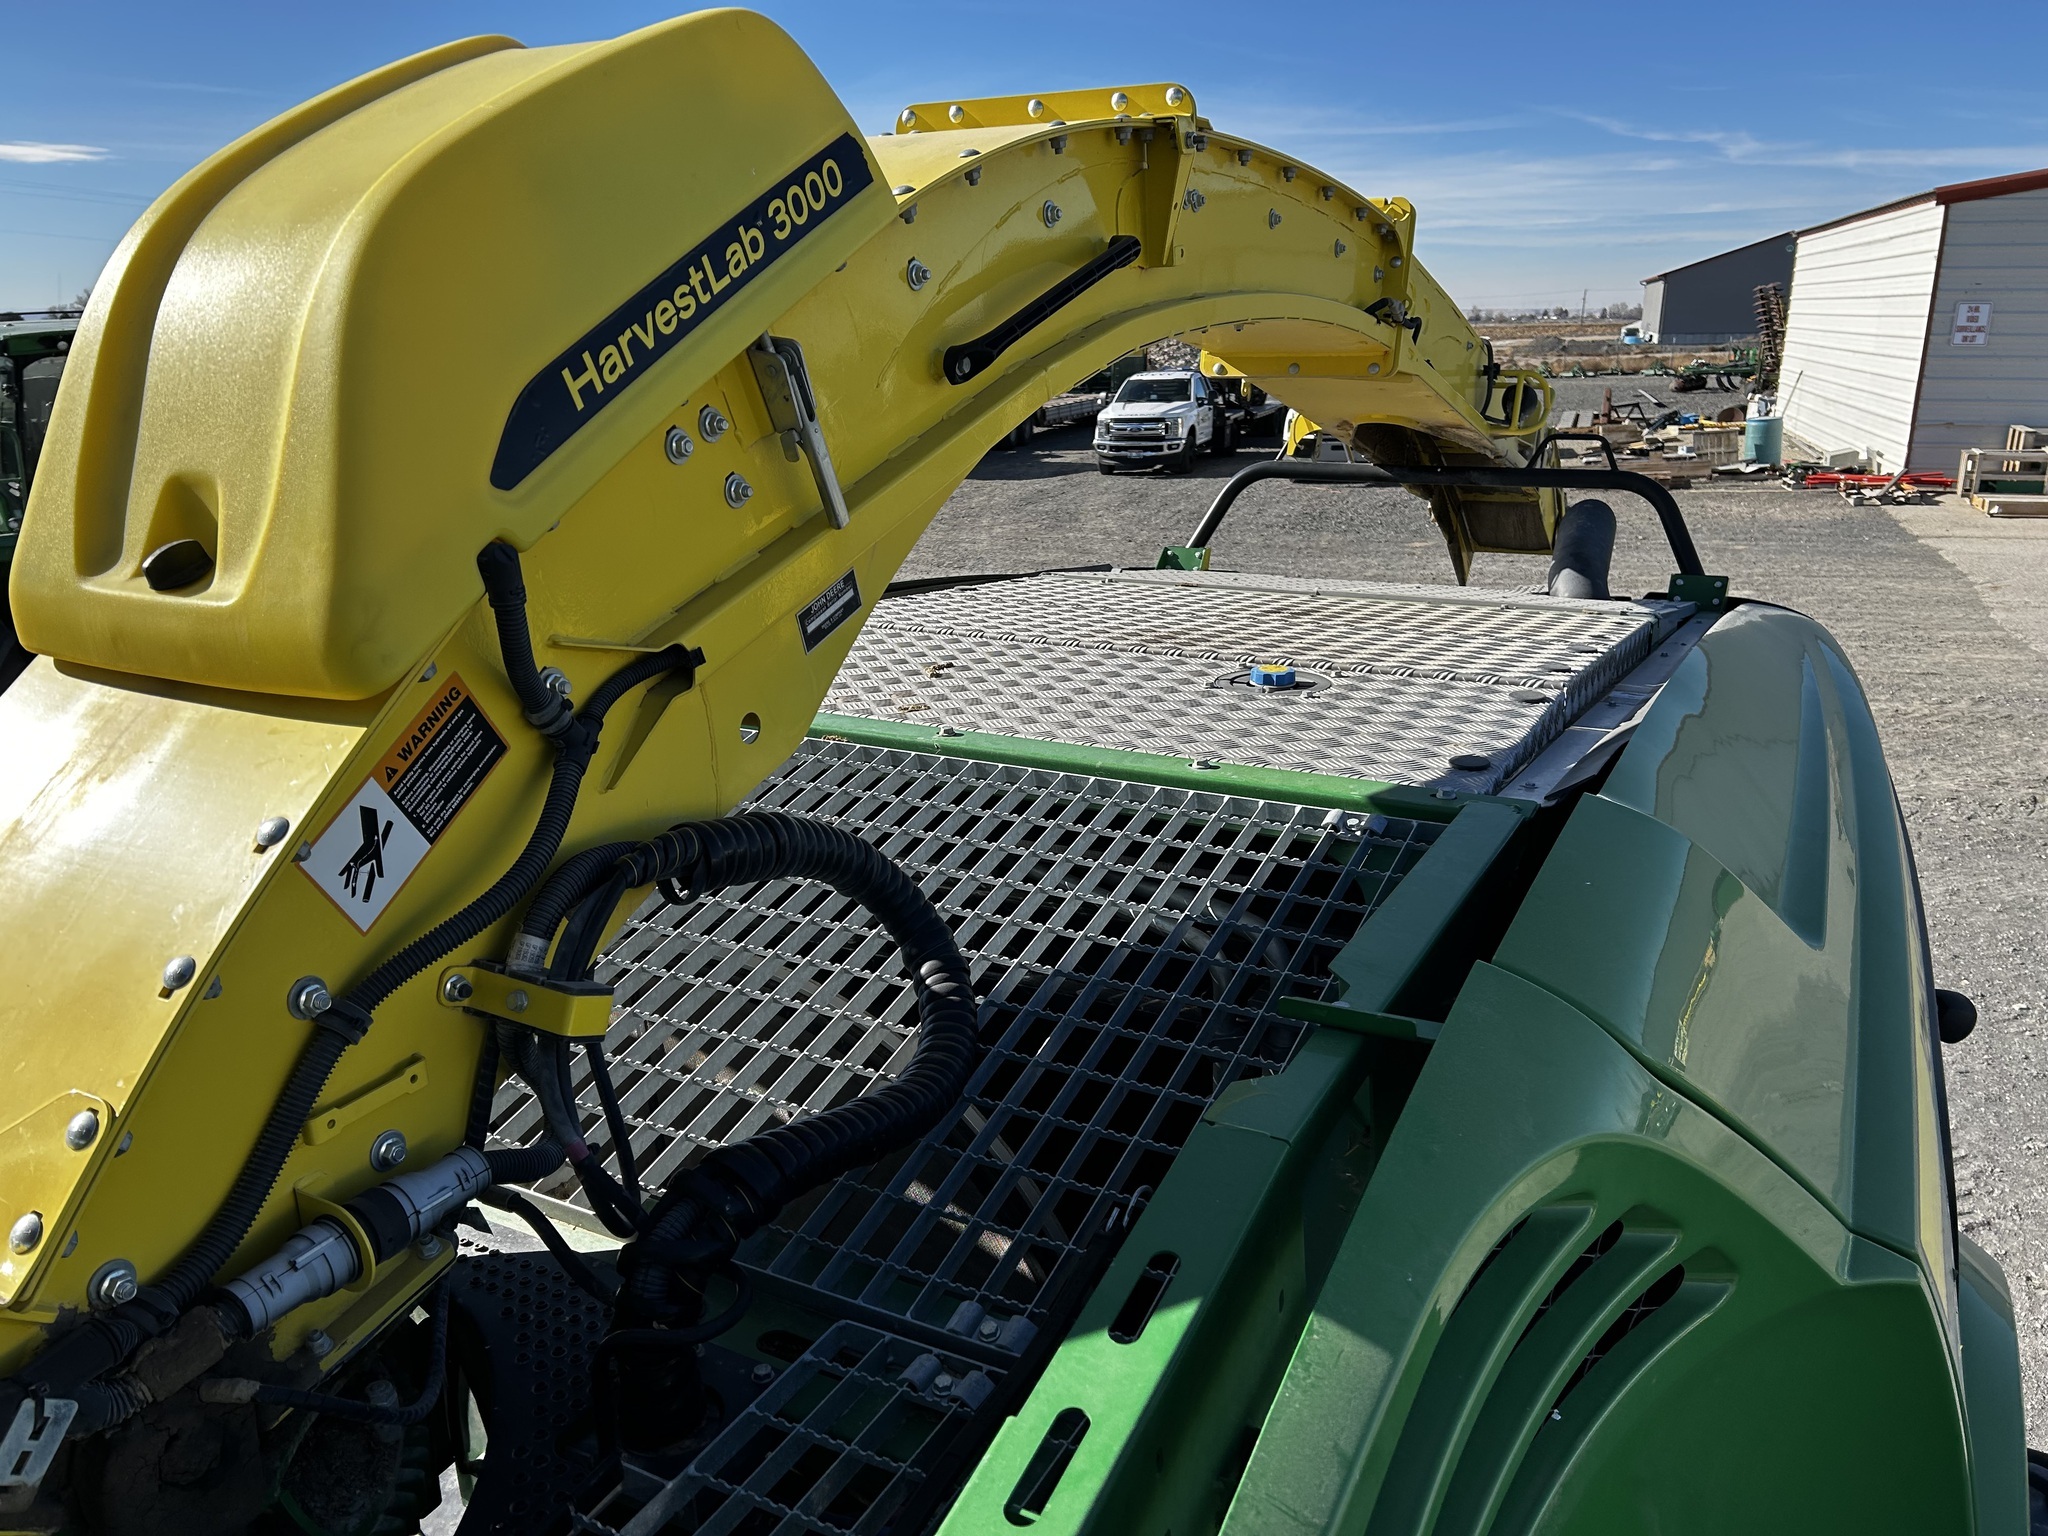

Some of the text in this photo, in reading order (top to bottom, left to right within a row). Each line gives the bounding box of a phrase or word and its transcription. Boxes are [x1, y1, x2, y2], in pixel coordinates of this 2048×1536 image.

[767, 158, 843, 240] 3000
[811, 580, 845, 614] JOHN DEERE
[397, 687, 462, 762] WARNING
[393, 783, 403, 795] Avoid
[403, 770, 413, 783] bodily
[425, 746, 433, 756] from
[401, 790, 413, 804] Before
[416, 802, 425, 813] Start
[443, 808, 452, 820] JOHN
[452, 794, 462, 808] DEERE
